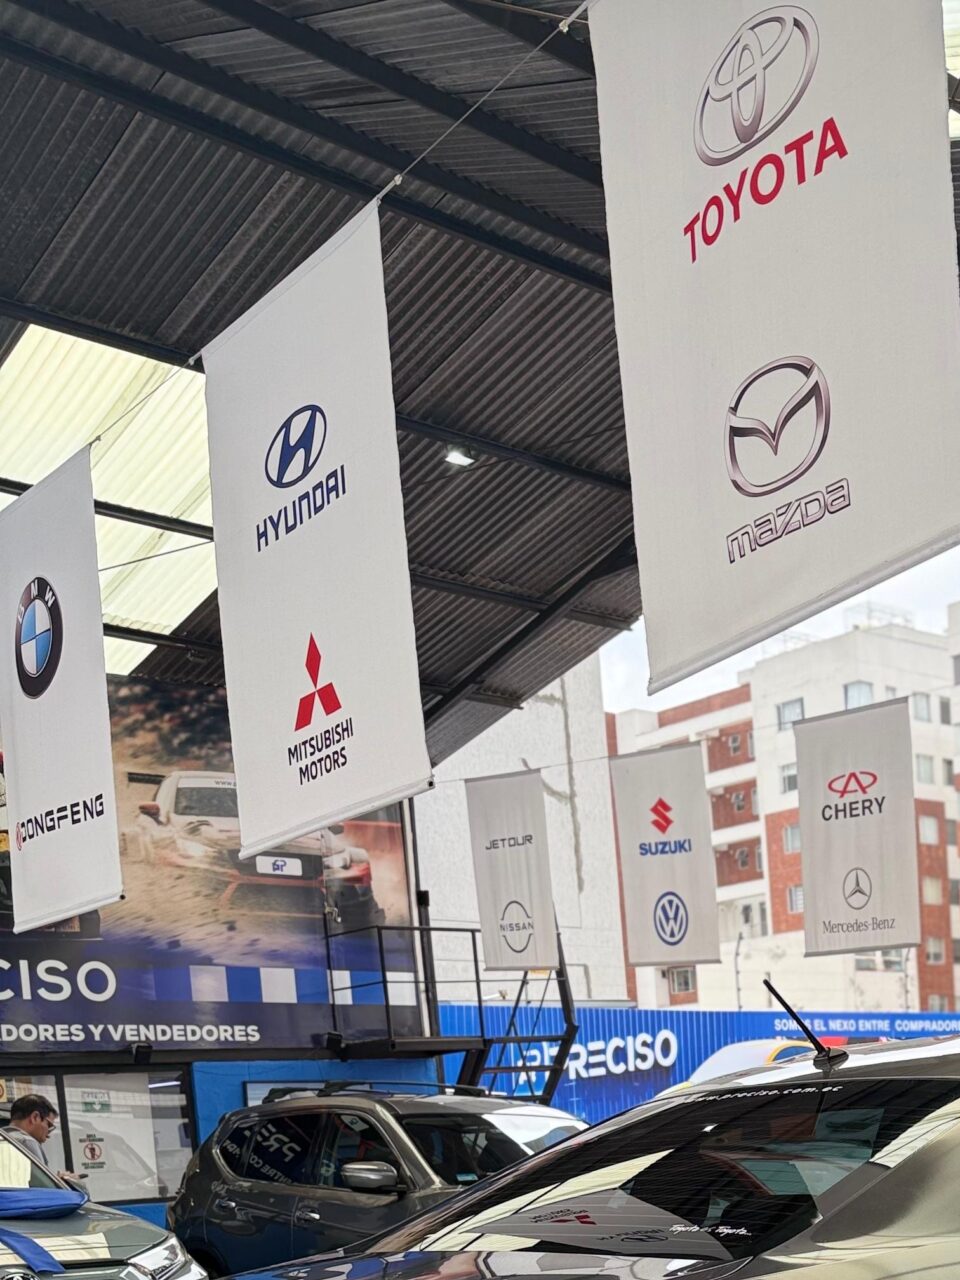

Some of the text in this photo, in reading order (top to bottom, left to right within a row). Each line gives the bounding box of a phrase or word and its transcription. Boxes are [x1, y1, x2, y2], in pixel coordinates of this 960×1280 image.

[683, 116, 849, 264] TOYOTA
[256, 464, 346, 552] HYUNDAI
[288, 718, 354, 765] MITSUBISHI
[299, 747, 348, 785] MOTORS
[20, 793, 105, 843] DONGFENG
[821, 796, 886, 821] CHERY
[485, 834, 533, 850] JETOUR
[639, 839, 692, 856] SUZUKI
[500, 922, 534, 932] NISSAN
[822, 917, 896, 935] Mercedes-Benz
[0, 1024, 261, 1042] DORES Y VENDEDORES
[814, 1019, 827, 1031] EL
[828, 1020, 855, 1031] NEXO
[858, 1020, 890, 1031] ENTRE
